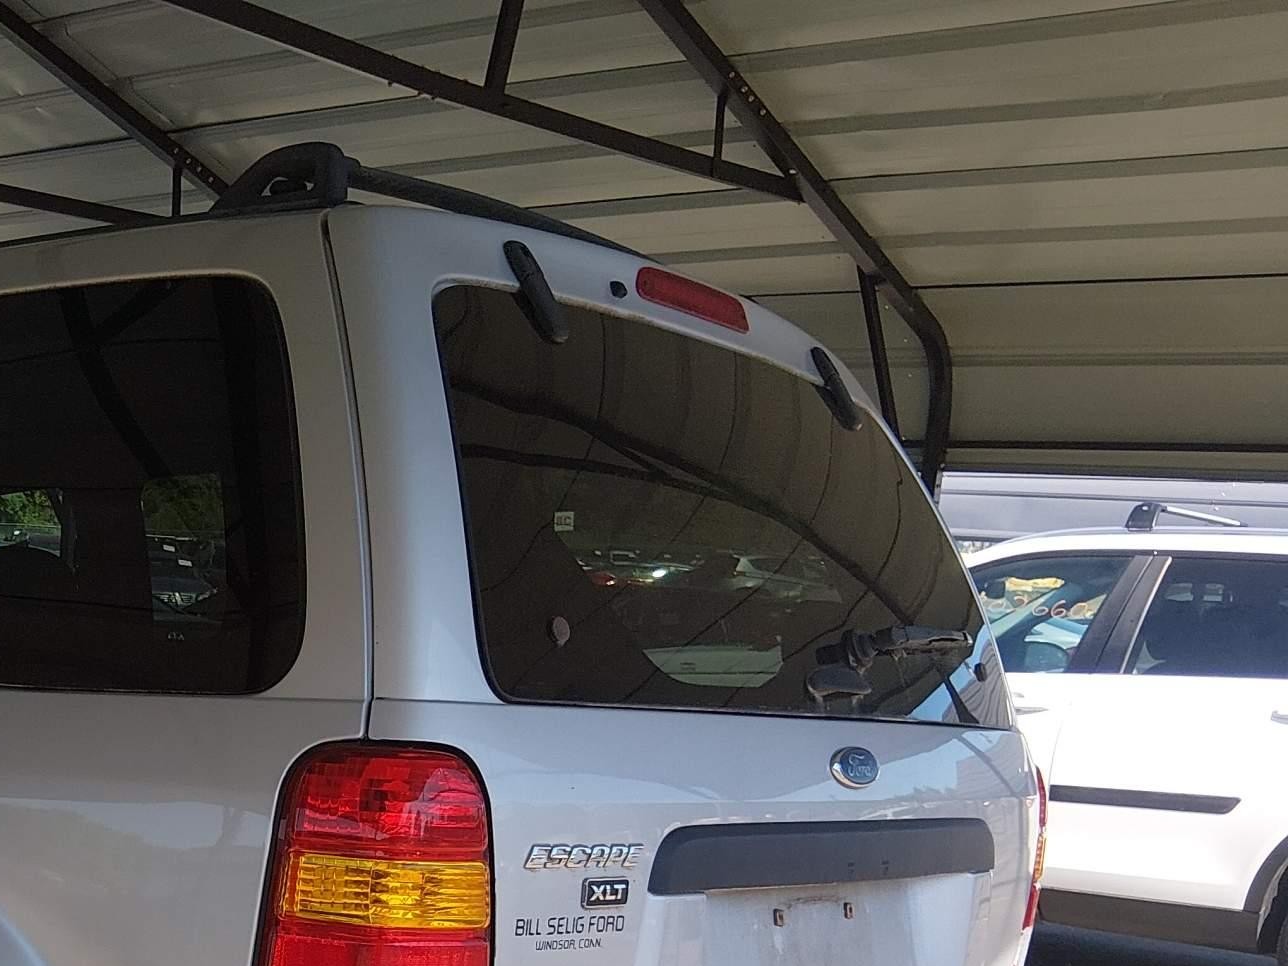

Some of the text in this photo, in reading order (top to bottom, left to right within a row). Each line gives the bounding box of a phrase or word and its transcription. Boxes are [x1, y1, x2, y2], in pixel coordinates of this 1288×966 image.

[524, 843, 644, 869] ESCAPE
[589, 884, 626, 901] XLT
[515, 915, 625, 936] BILL SELIG FORD
